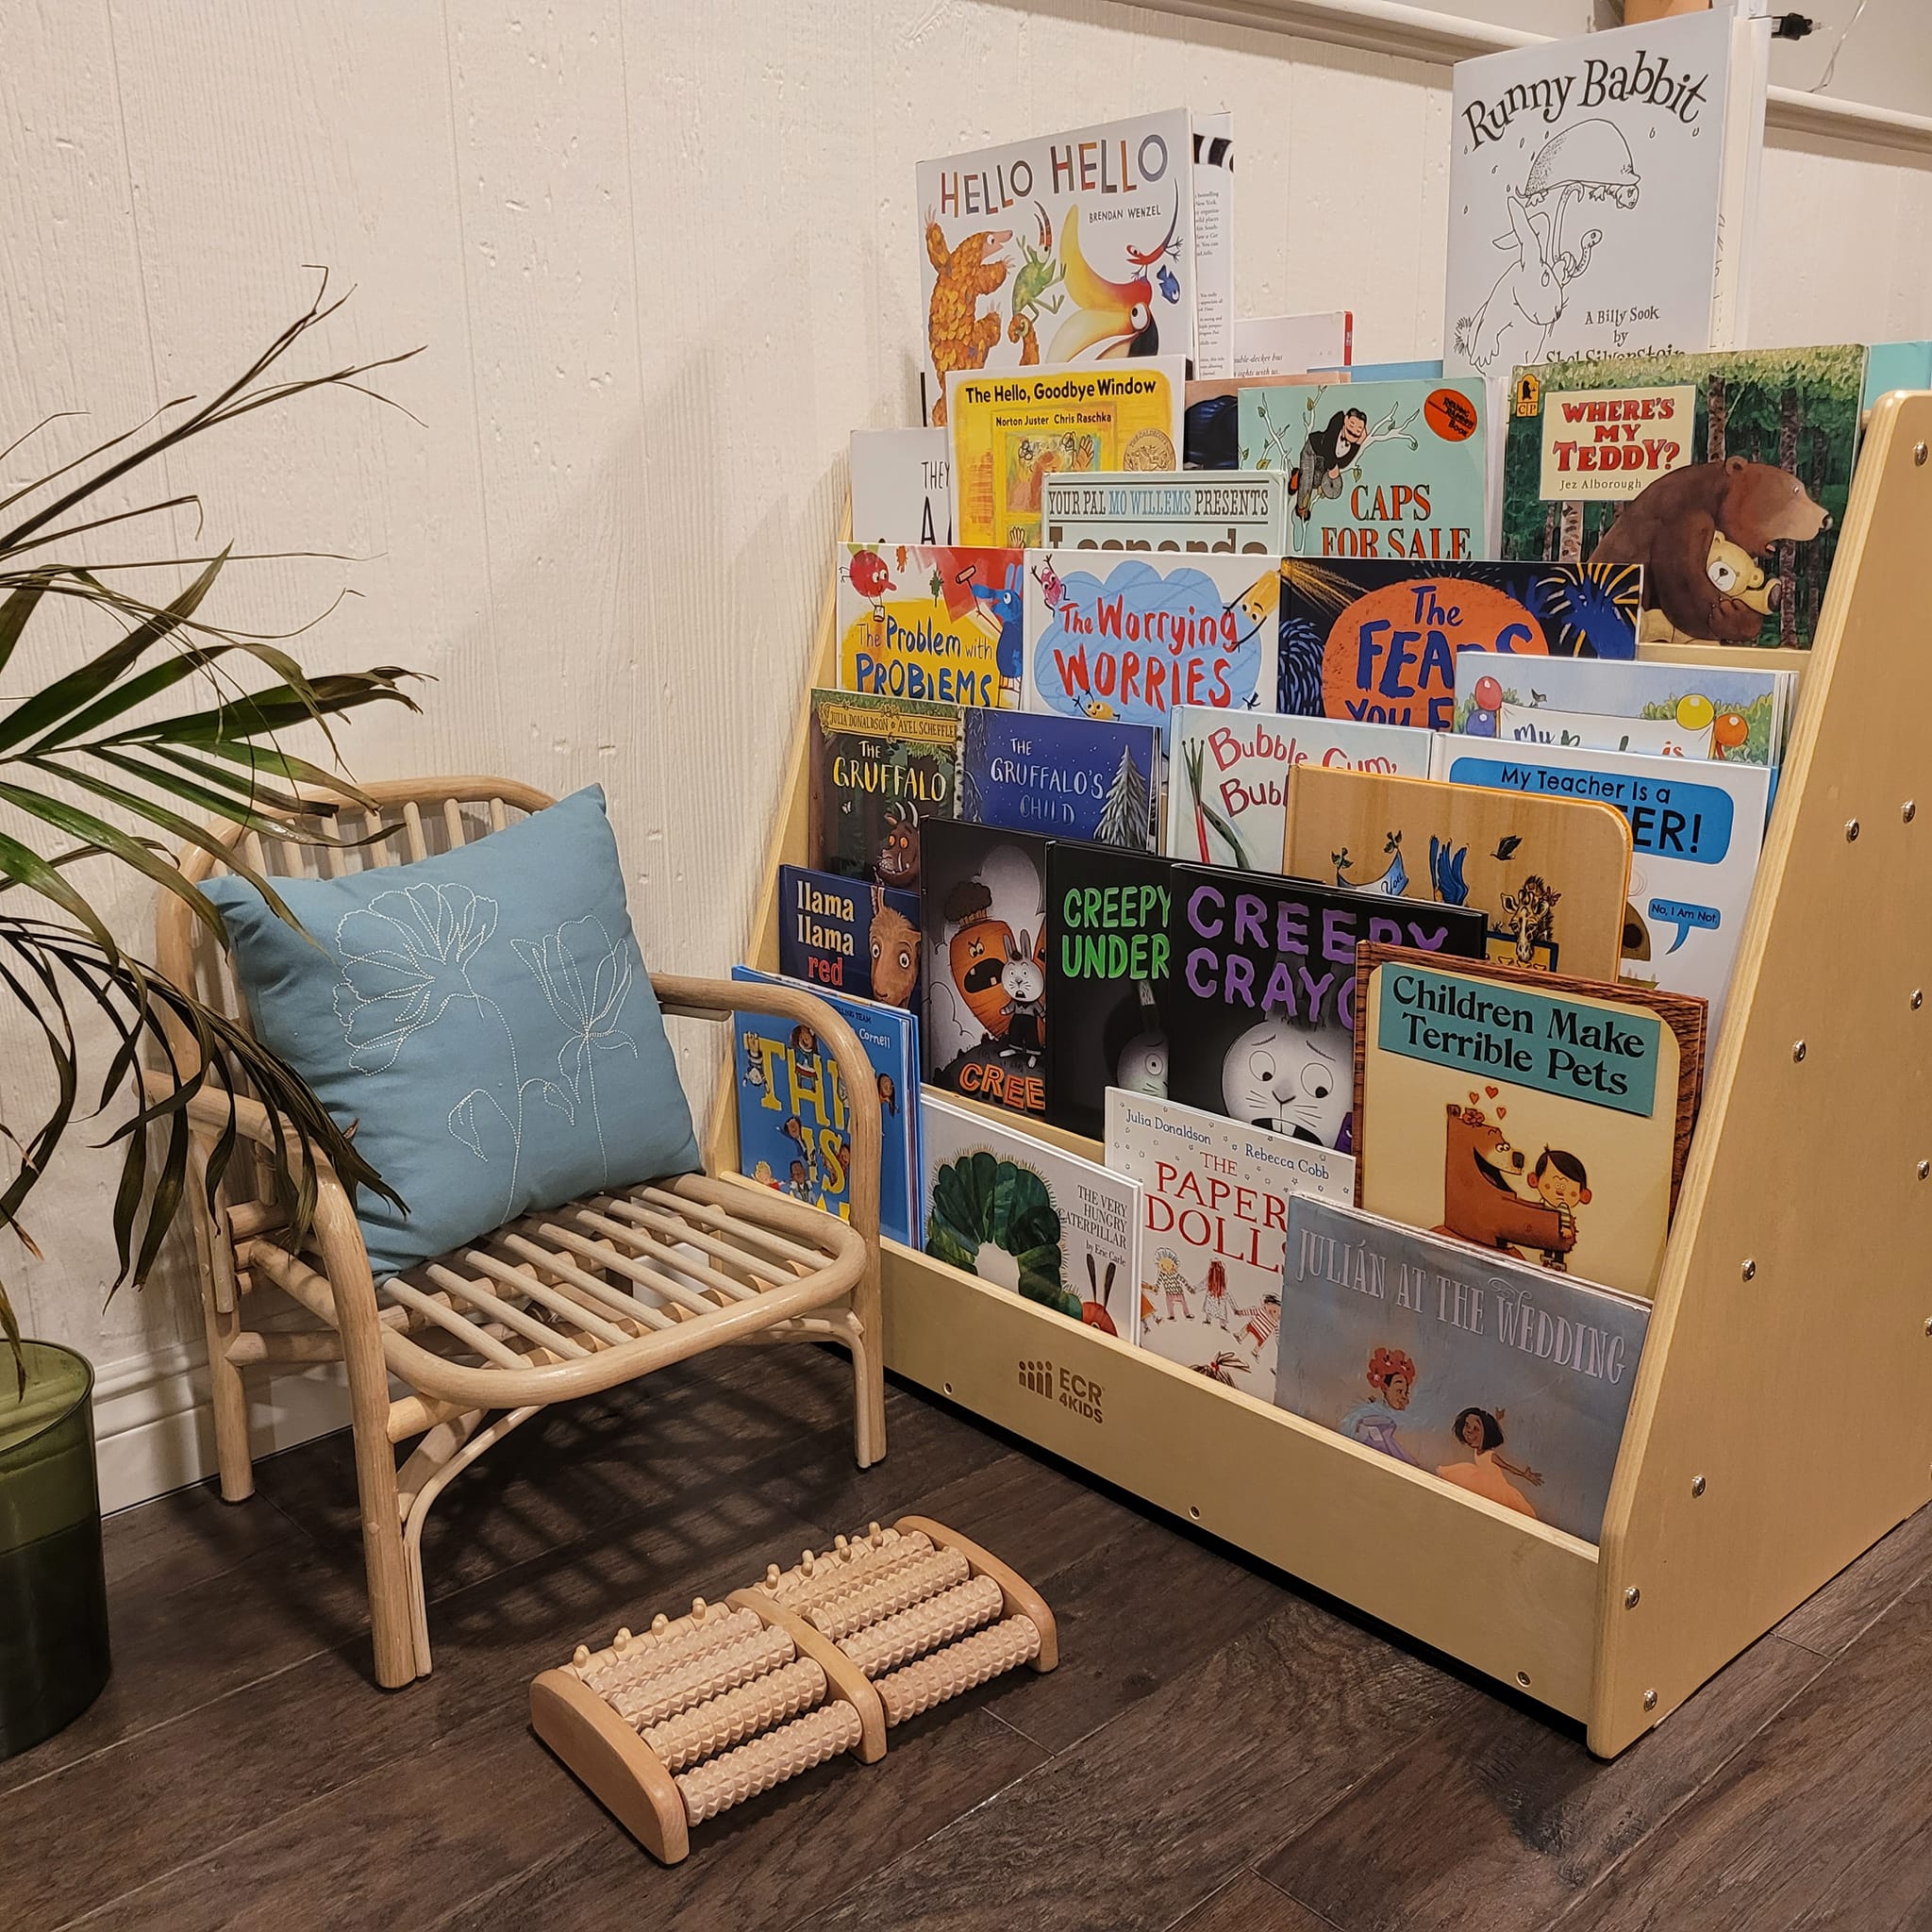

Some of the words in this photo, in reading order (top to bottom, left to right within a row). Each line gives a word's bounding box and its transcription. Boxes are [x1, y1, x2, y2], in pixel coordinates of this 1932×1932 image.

[1461, 75, 1577, 152] Runny
[1577, 50, 1708, 125] Babbit
[941, 160, 1034, 218] HELLO
[1050, 134, 1169, 195] HELLO
[1089, 209, 1124, 224] BRENDAN
[1127, 205, 1162, 219] WENZEL
[1585, 311, 1593, 325] A
[1597, 308, 1627, 326] Billy
[1630, 306, 1660, 322] Sook
[1613, 330, 1629, 346] by
[966, 387, 991, 404] The
[994, 385, 1031, 404] Hello,
[1034, 382, 1095, 402] Goodbye
[1097, 377, 1157, 396] Window
[1561, 397, 1675, 423] WHERE'S
[995, 415, 1024, 427] Norton
[1024, 414, 1049, 426] Juster
[1054, 413, 1075, 425] Chris
[1076, 412, 1112, 424] Raschka
[1593, 424, 1641, 442] MY
[1553, 439, 1680, 472] TEDDY?
[921, 460, 950, 491] THEY
[1559, 479, 1578, 491] Jez
[1581, 477, 1642, 493] Alborough
[1048, 490, 1080, 515] YOUR
[1082, 490, 1107, 515] PAL
[1108, 490, 1127, 515] MO
[1131, 490, 1191, 515] WILLEMS
[1194, 490, 1270, 515] PRESENTS
[1349, 483, 1432, 521] CAPS
[1322, 527, 1380, 558] FOR
[1387, 527, 1472, 560] SALE
[1058, 603, 1094, 637] The
[1096, 594, 1240, 657] Worrying
[1410, 585, 1464, 627] The
[858, 623, 882, 648] The
[886, 615, 961, 658] Problem
[964, 638, 993, 660] with
[1053, 643, 1233, 709] WORRIES
[1357, 619, 1533, 699] FEA
[855, 652, 993, 708] PROBLEMS
[829, 711, 847, 726] JULIA
[849, 713, 889, 731] DONALDSON
[897, 720, 918, 735] AXEL
[919, 721, 958, 739] SCHEFFLE
[858, 741, 881, 759] THE
[1010, 738, 1033, 757] THE
[1208, 724, 1308, 772] Bubble
[833, 756, 947, 803] GRUFFALO
[990, 757, 1105, 800] GRUFFALO'S
[1501, 765, 1531, 791] My
[1538, 770, 1625, 799] Teacher
[1632, 780, 1648, 802] Is
[1656, 789, 1671, 804] a
[1020, 794, 1076, 826] CHILD
[1623, 805, 1702, 855] ER!
[796, 879, 855, 924] llama
[1063, 885, 1171, 929] CREEPY
[1652, 903, 1667, 916] No,
[1677, 908, 1694, 920] Am
[796, 912, 855, 958] llama
[808, 954, 843, 987] red
[1061, 933, 1171, 980] UNDER
[1392, 974, 1535, 1035] Children
[1546, 1008, 1646, 1059] Make
[858, 1027, 891, 1050] Cornell
[1400, 1011, 1534, 1073] Terrible
[1546, 1049, 1629, 1097] Pets
[743, 1031, 850, 1129] THI
[958, 1062, 1046, 1111] CREE
[1124, 1108, 1153, 1130] Julia
[1154, 1116, 1212, 1146] Donaldson
[1244, 1143, 1296, 1170] Rebecca
[1298, 1158, 1330, 1181] Cobb
[1199, 1151, 1239, 1177] THE
[1077, 1184, 1099, 1206] THE
[1100, 1194, 1128, 1218] VERY
[1154, 1160, 1288, 1234] PAPER
[1057, 1208, 1127, 1251] CATERPILLAR
[1084, 1203, 1128, 1234] HUNGRY
[1144, 1193, 1287, 1276] DOLL
[1094, 1243, 1108, 1258] Eric
[1108, 1251, 1126, 1267] Carle
[1295, 1228, 1387, 1301] JULIÁN
[1395, 1262, 1428, 1314] AT
[1436, 1274, 1486, 1337] THE
[1488, 1276, 1627, 1386] WEDDING
[1059, 1367, 1103, 1407] ECR
[1058, 1391, 1104, 1424] 4KIDS
